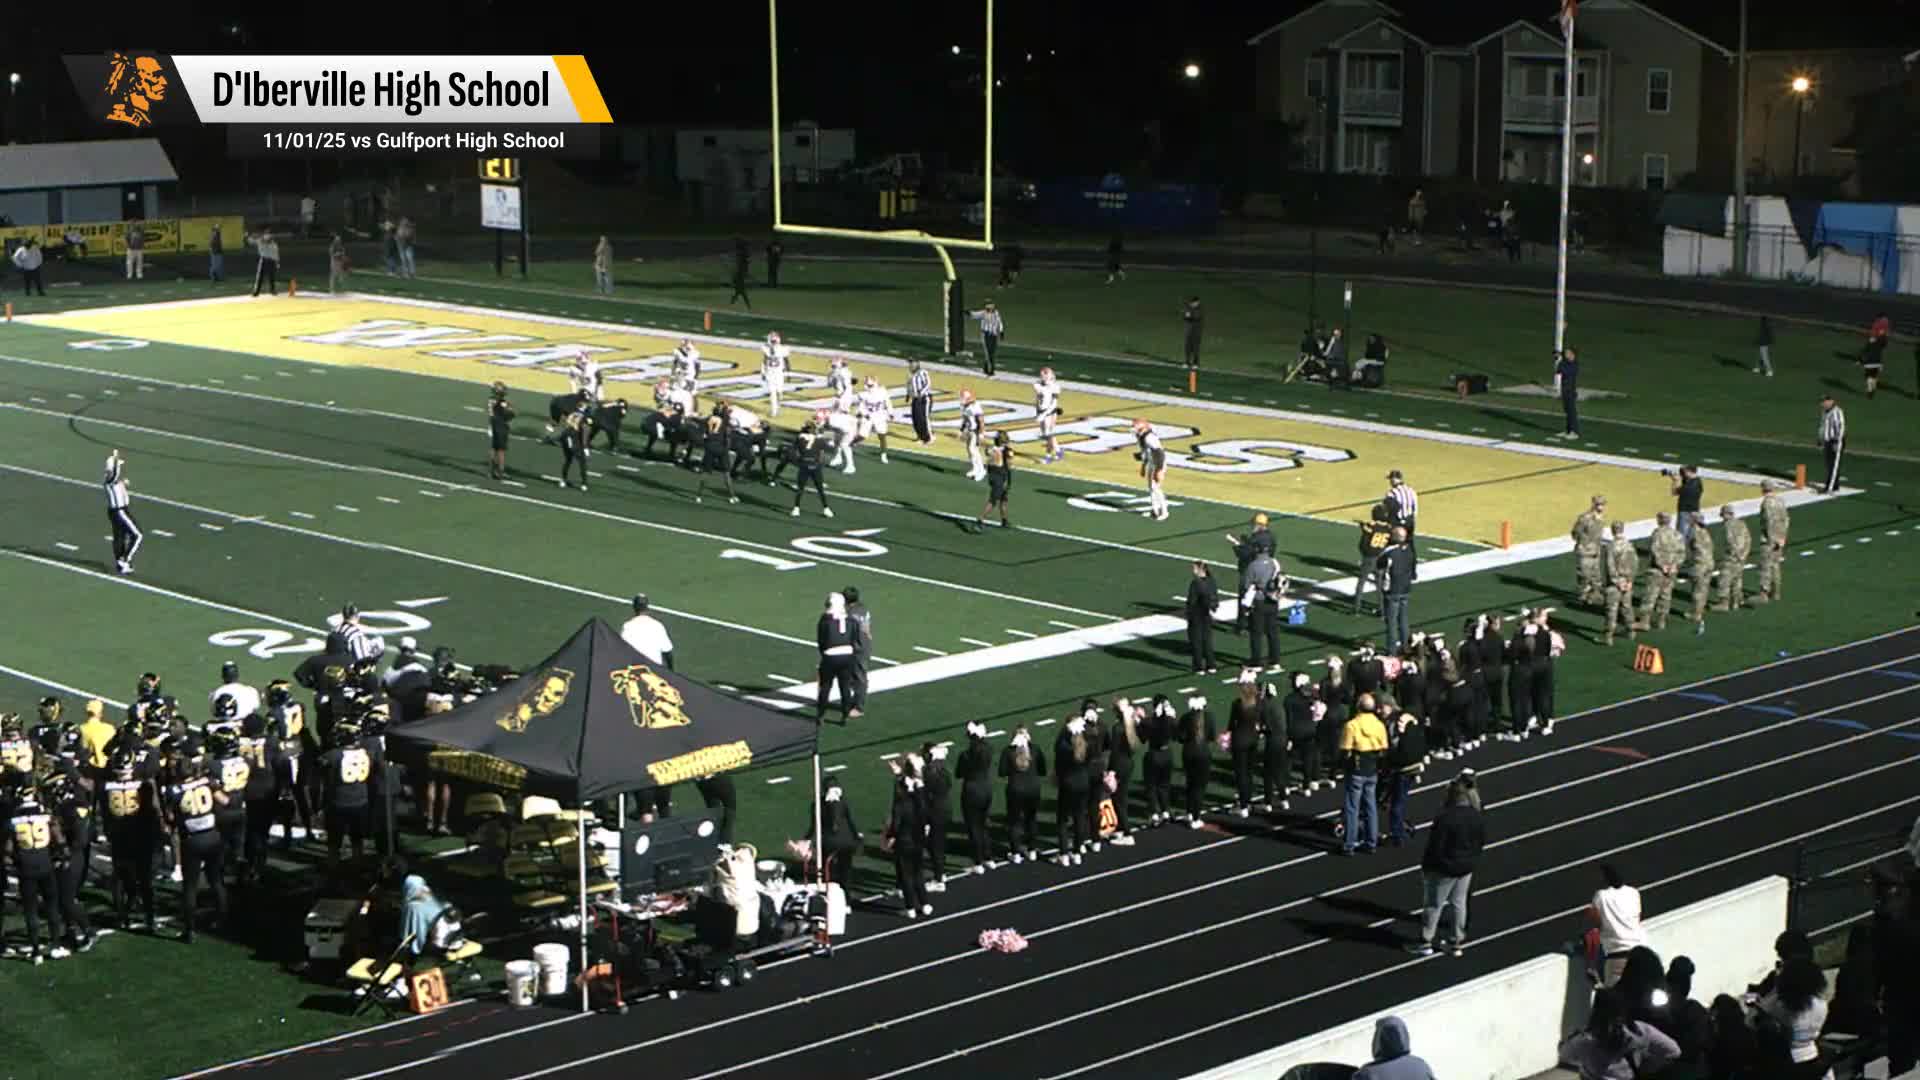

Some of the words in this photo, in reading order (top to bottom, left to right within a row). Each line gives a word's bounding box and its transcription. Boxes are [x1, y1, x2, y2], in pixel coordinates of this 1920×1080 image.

[719, 536, 889, 571] 10
[208, 610, 432, 659] 20
[1637, 647, 1655, 671] 10
